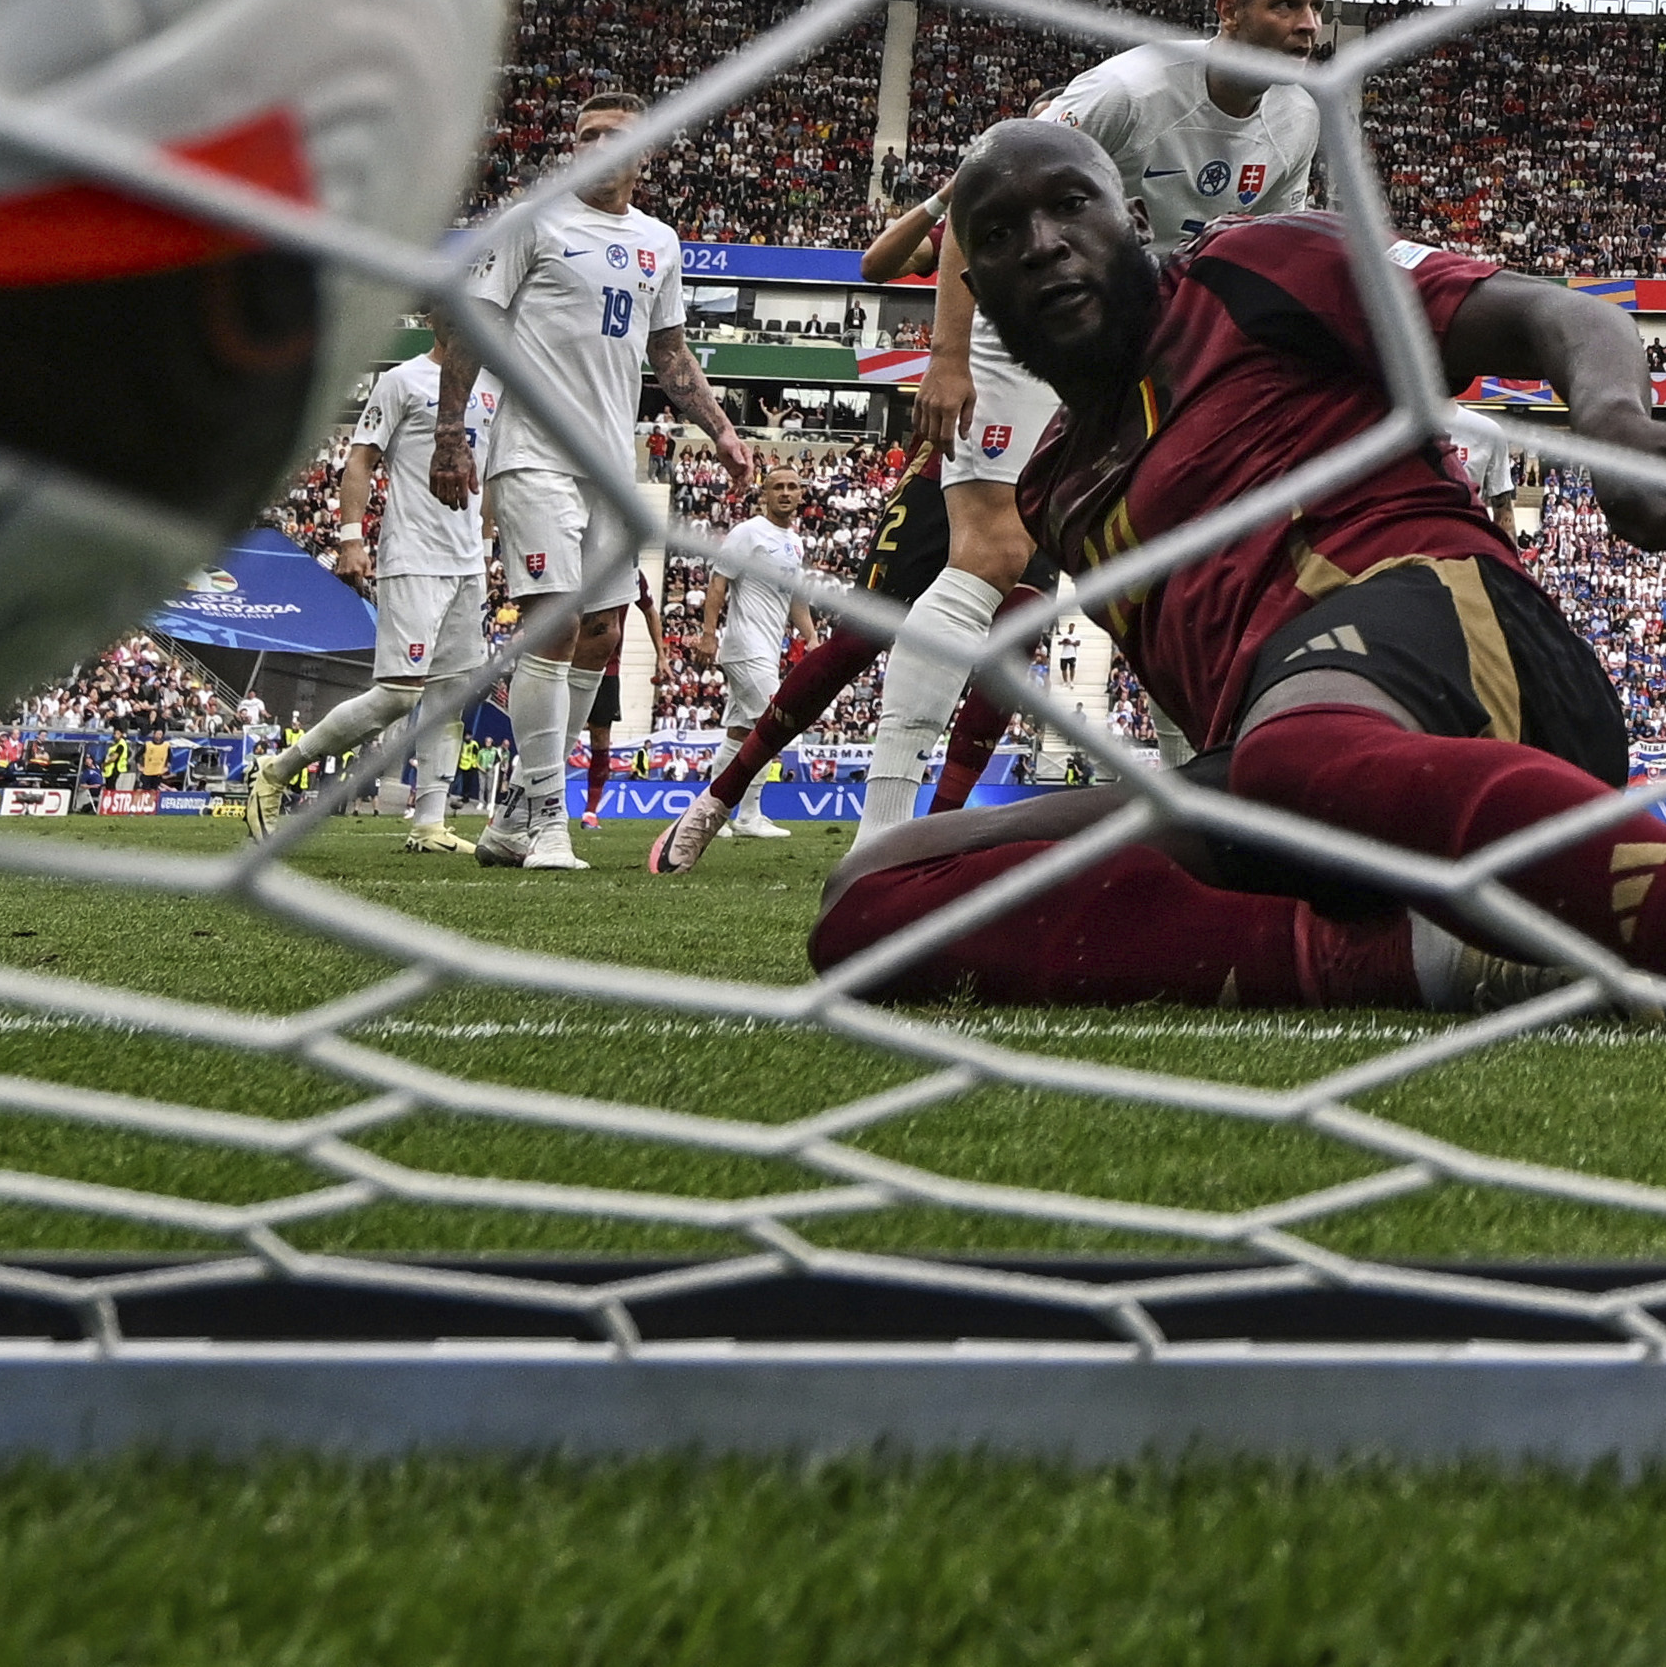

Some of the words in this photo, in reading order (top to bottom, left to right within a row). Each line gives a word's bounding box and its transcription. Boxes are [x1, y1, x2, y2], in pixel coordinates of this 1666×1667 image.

[601, 285, 633, 339] 19
[876, 504, 907, 552] 2
[162, 599, 302, 615] EURO2024
[201, 609, 277, 620] GERMANY
